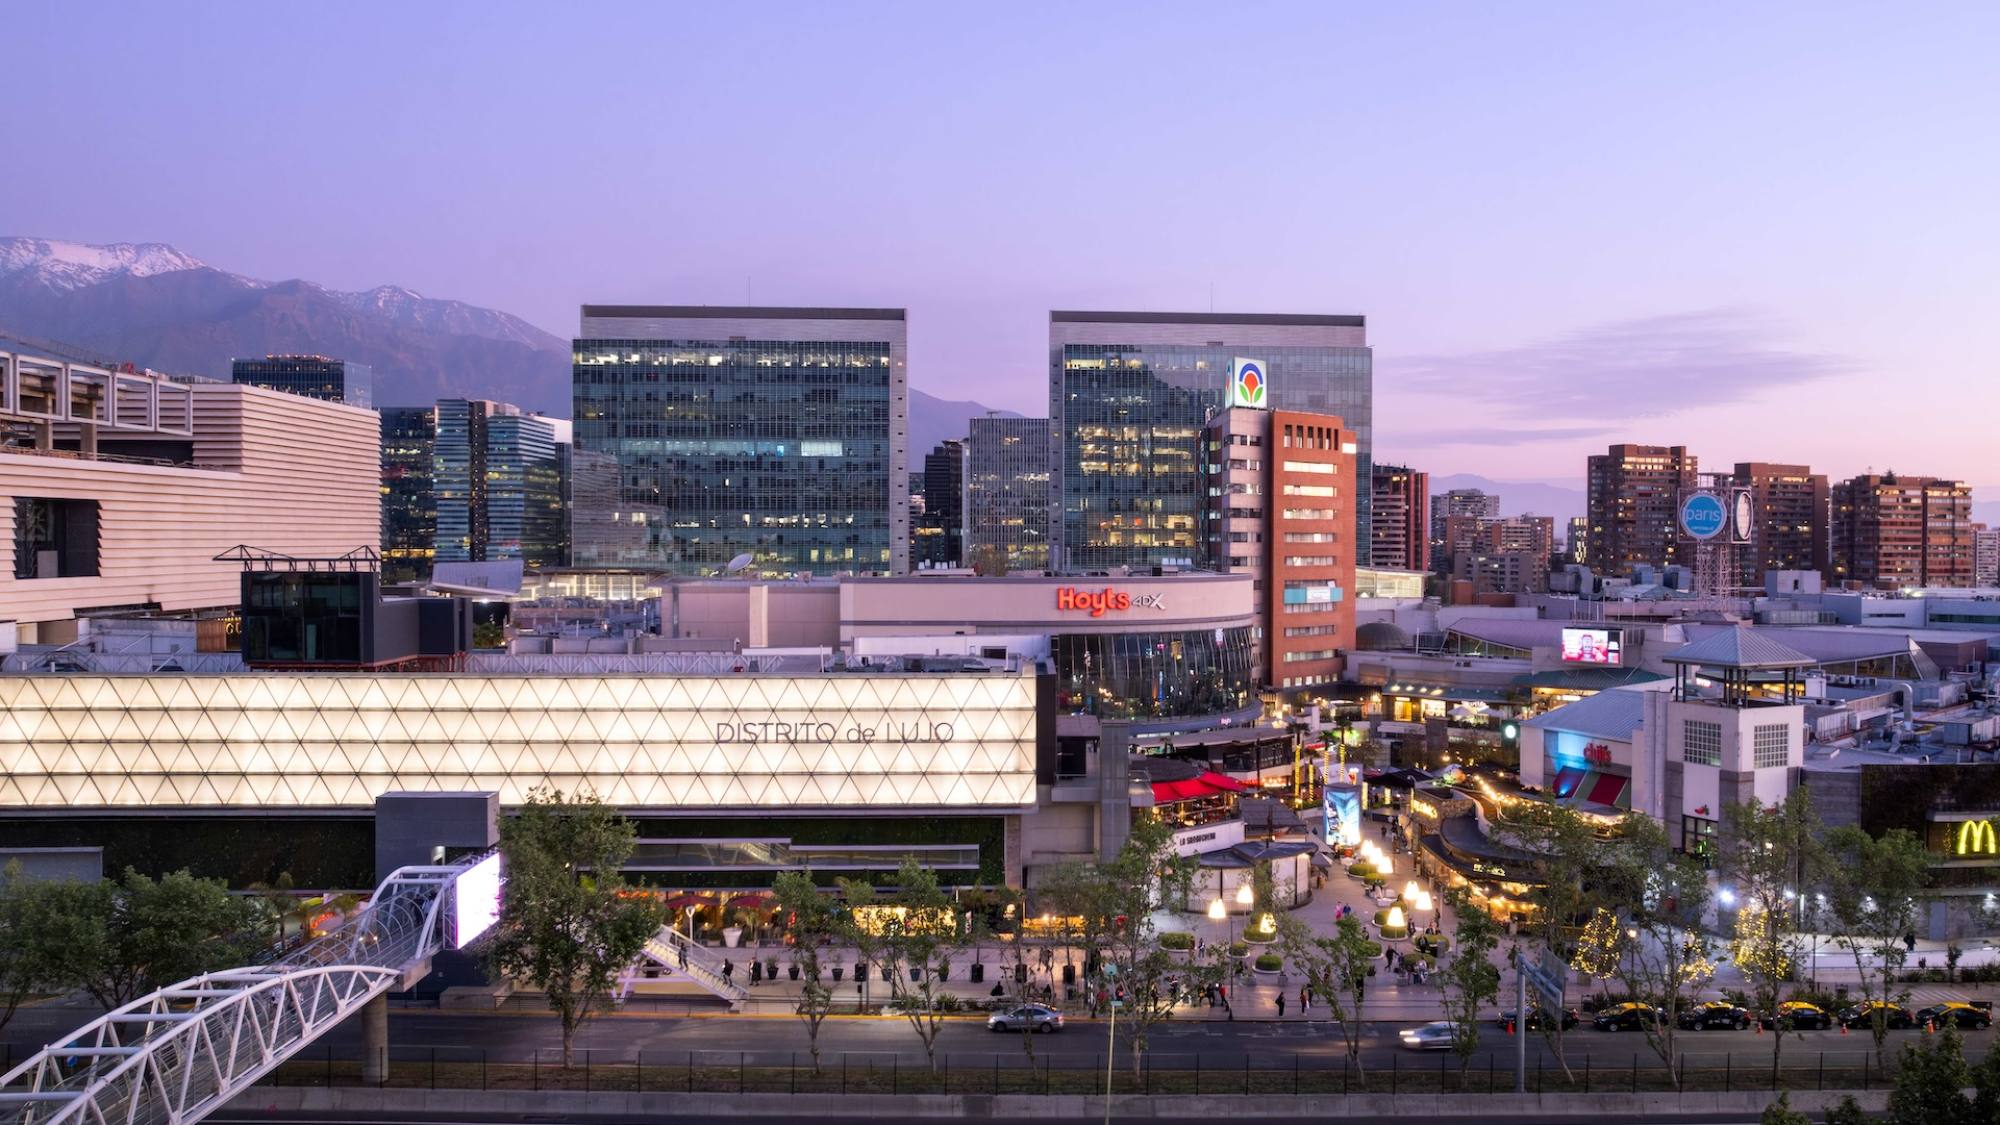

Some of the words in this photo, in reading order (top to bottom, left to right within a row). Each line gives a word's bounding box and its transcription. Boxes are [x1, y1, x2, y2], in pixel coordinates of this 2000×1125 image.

[1685, 508, 1720, 523] paris
[1057, 587, 1130, 617] Hoyts
[1132, 593, 1166, 611] 4DX
[716, 722, 837, 744] DISTRITO
[846, 723, 876, 743] de
[886, 722, 954, 744] LUJO
